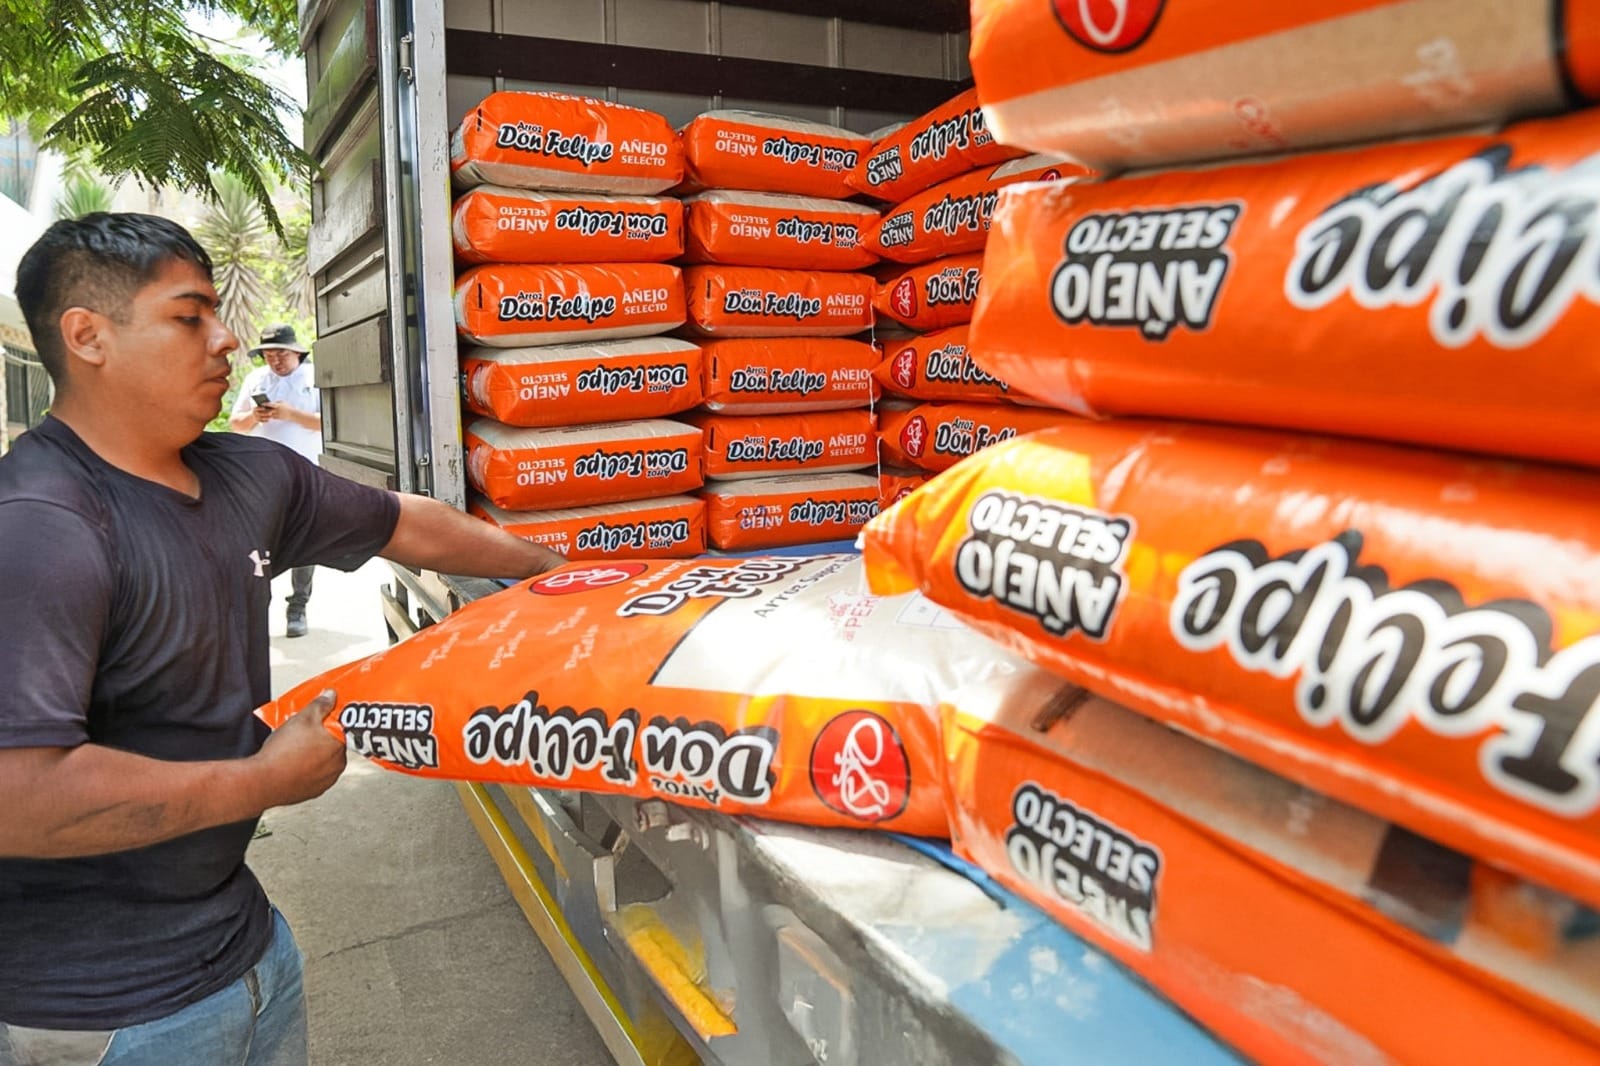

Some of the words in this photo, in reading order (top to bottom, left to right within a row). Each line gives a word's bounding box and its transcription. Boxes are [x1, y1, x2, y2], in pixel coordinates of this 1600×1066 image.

[517, 121, 542, 133] Arroz
[717, 129, 756, 142] SELECTO
[909, 111, 971, 163] Felipe
[497, 125, 542, 150] Don
[545, 131, 614, 167] Felipe
[620, 139, 668, 155] AÑEJO
[715, 139, 758, 157] AÑEJO
[763, 137, 821, 165] Felipe
[621, 155, 666, 166] SELECTO
[823, 148, 858, 168] Don
[867, 145, 901, 169] SELECO
[866, 158, 904, 186] AÑEO
[500, 207, 547, 217] SELECTO
[556, 207, 624, 237] Felipe
[731, 214, 769, 225] SELECTO
[923, 193, 981, 236] Felipe
[498, 217, 549, 235] AÑEJO
[626, 214, 667, 236] Don
[626, 230, 651, 241] Arroz
[729, 224, 771, 240] AÑEJO
[776, 217, 834, 245] Felipe
[835, 224, 861, 244] on
[1066, 200, 1244, 257] SELECTO
[879, 225, 915, 248] AÑEJO
[1284, 145, 1600, 350] lipe
[941, 267, 963, 279] Arroz
[518, 291, 543, 301] Arroz
[622, 288, 669, 304] AÑEJO
[740, 288, 762, 297] Arroz
[826, 293, 865, 306] AÑEJO
[926, 277, 961, 306] Don
[1050, 248, 1234, 341] AÑEJO
[498, 296, 545, 321] Don
[547, 293, 617, 323] Felipe
[624, 303, 668, 315] SELECTO
[724, 292, 762, 314] Don
[764, 292, 822, 320] Felipe
[827, 307, 864, 316] SELECTO
[942, 344, 965, 356] Arroz
[646, 364, 688, 388] Don
[745, 366, 768, 375] Arroz
[831, 368, 870, 381] AÑEJO
[925, 351, 962, 381] Don
[521, 372, 568, 385] SELECTO
[576, 365, 643, 396] Felipe
[647, 383, 673, 394] Arroz
[729, 370, 767, 393] Don
[769, 368, 826, 396] Felipe
[832, 382, 868, 391] SELECTO
[520, 384, 570, 400] AÑEJO
[951, 417, 974, 430] Arroz
[744, 436, 766, 445] Arroz
[829, 433, 867, 448] AÑEJO
[935, 423, 974, 455] Don
[646, 448, 688, 471] Don
[726, 440, 766, 462] Don
[767, 436, 824, 464] Felipe
[830, 447, 865, 457] SELECTO
[518, 457, 566, 470] SELECTO
[573, 449, 643, 479] Felipe
[646, 468, 672, 479] Arroz
[517, 469, 568, 487] AÑEJO
[740, 515, 784, 530] AÑEJO
[789, 499, 847, 526] Felipe
[576, 521, 644, 552] Felipe
[646, 518, 689, 543] Don
[969, 492, 1134, 564] SELECTO
[648, 538, 673, 550] Arroz
[616, 565, 734, 618] Don
[954, 538, 1130, 641] AÑEJO
[340, 702, 433, 732] SELECTO
[463, 691, 639, 787] Felipe
[640, 716, 779, 805] Don
[651, 777, 721, 807] Arroz
[1012, 783, 1164, 896] SELECTO
